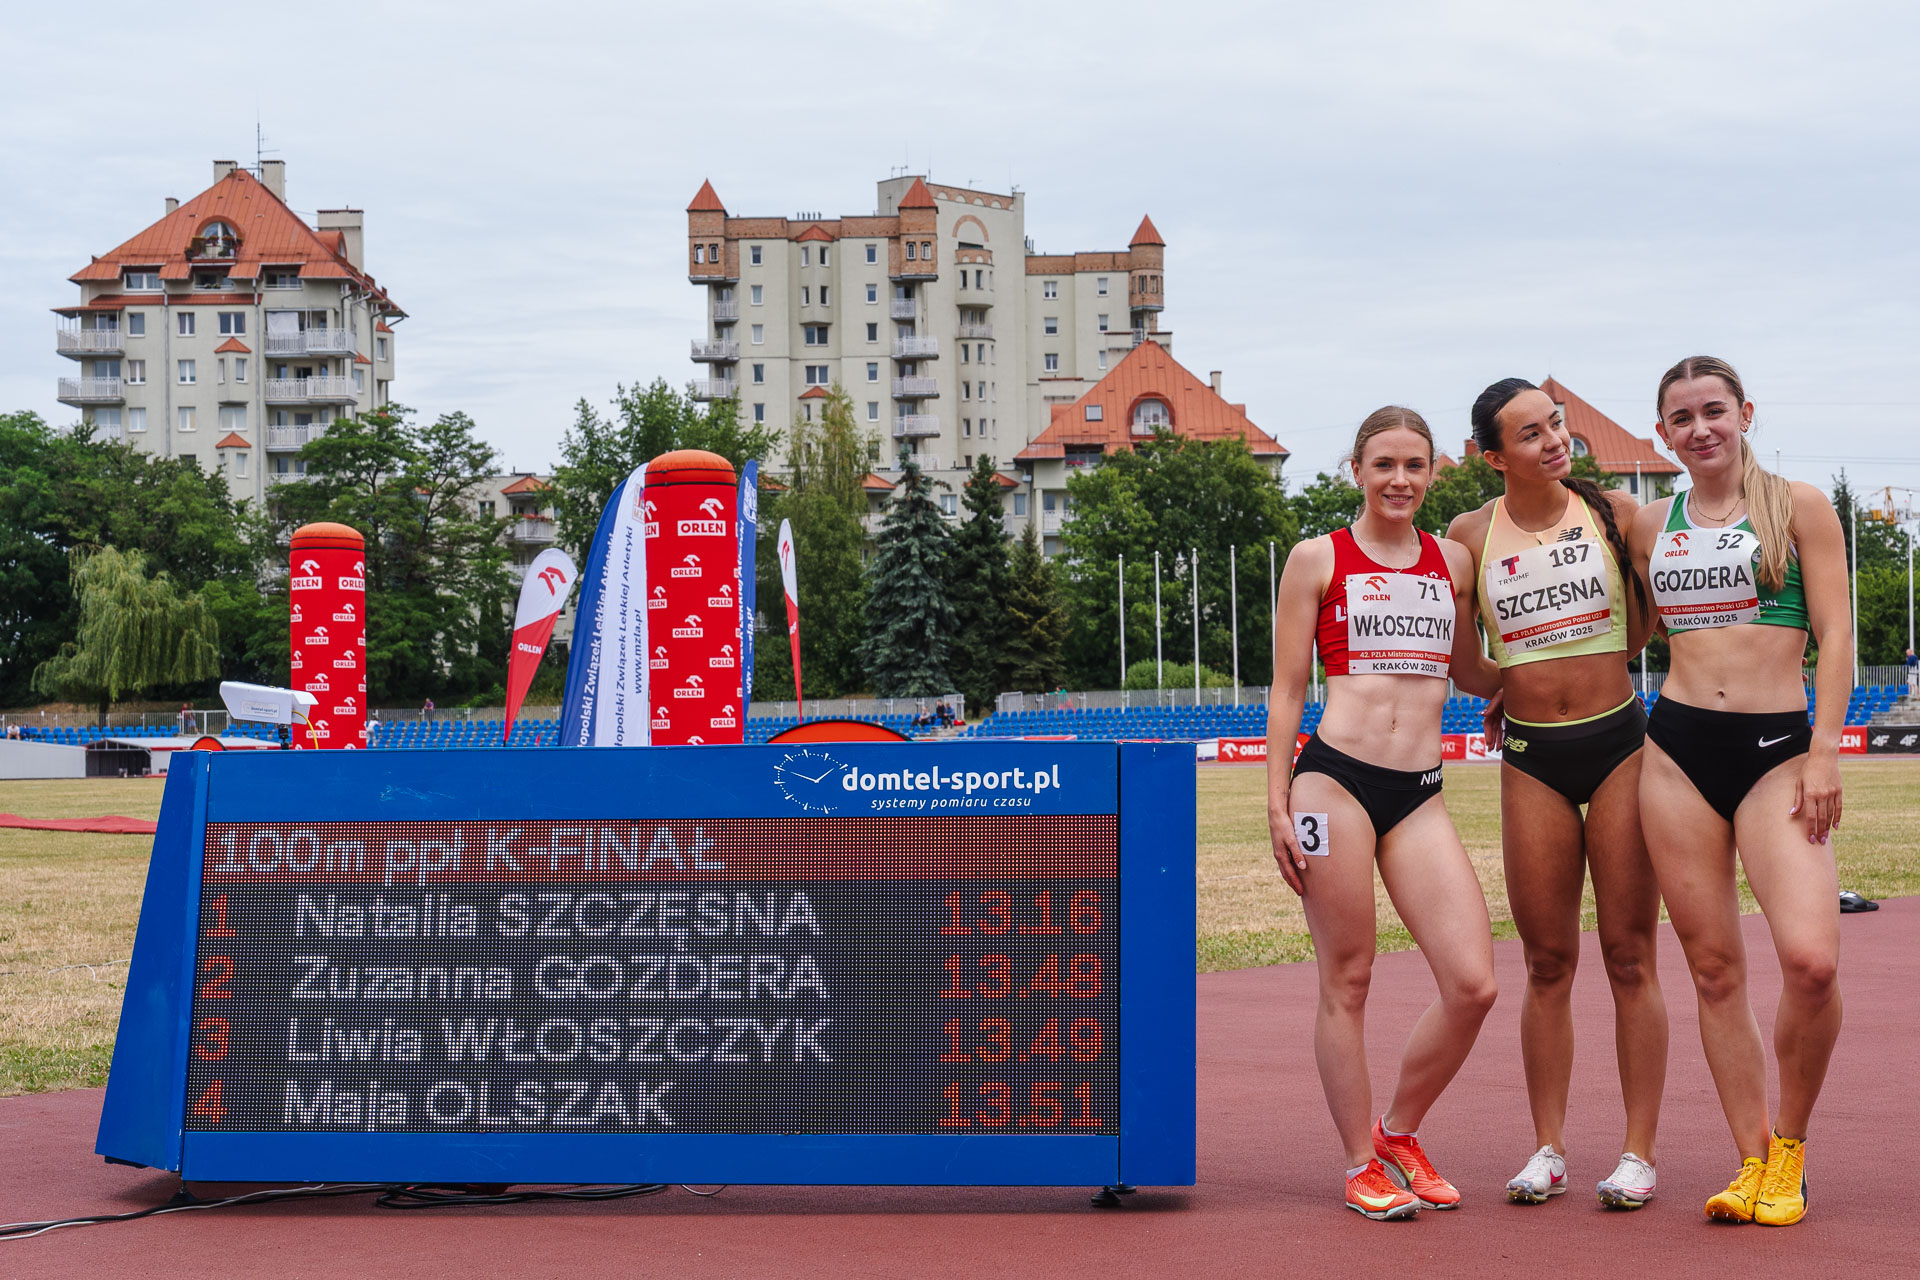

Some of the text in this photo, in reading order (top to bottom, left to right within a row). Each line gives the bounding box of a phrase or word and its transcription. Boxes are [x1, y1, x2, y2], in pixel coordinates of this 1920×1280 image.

[681, 523, 723, 533] ORLEN
[622, 526, 633, 582] Atletyki
[1716, 533, 1744, 550] 52
[1549, 544, 1589, 568] 187
[292, 579, 319, 588] ORLEN
[1417, 581, 1440, 601] 71
[1498, 572, 1529, 586] TRYUMF
[1653, 565, 1751, 592] GOZDERA
[619, 583, 631, 631] Lekkiej
[1496, 576, 1605, 621] SZCZĘSNA
[1683, 605, 1715, 613] Mistrzostwa
[1716, 603, 1735, 611] Polski
[1735, 601, 1749, 609] U23
[1353, 615, 1452, 641] WŁOSZCZYK
[1511, 632, 1521, 640] 42.
[1520, 629, 1535, 637] PZLA
[1534, 619, 1572, 634] Mistrzostwa
[1572, 614, 1591, 624] Polski
[1673, 614, 1738, 626] KRAKÓW 2025
[518, 642, 542, 654] ORLEN
[1525, 625, 1594, 649] KRAKÓW 2025
[616, 635, 627, 691] Związek
[634, 609, 643, 694] www.mzla.pl
[1424, 652, 1438, 660] Polski
[584, 640, 601, 695] Związek
[1372, 660, 1438, 672] KRAKÓW 2025
[1872, 735, 1918, 747] 4F 4F
[842, 764, 1061, 794] domtel-sport.pl
[871, 796, 1031, 810] systemy pomiaru czasu
[1301, 815, 1321, 852] 3
[214, 826, 726, 887] 100m ppł K-FINAŁ
[205, 890, 1102, 951] 1 Natalia SZCZĘSNA 13.16
[201, 953, 1102, 999] 2 Zuzanna GOZDERA 13.48
[196, 1017, 1103, 1062] 3 Liwia WŁOSZCZYK 13.49
[193, 1079, 1103, 1131] 4 Maja OLSZAK 13.51
